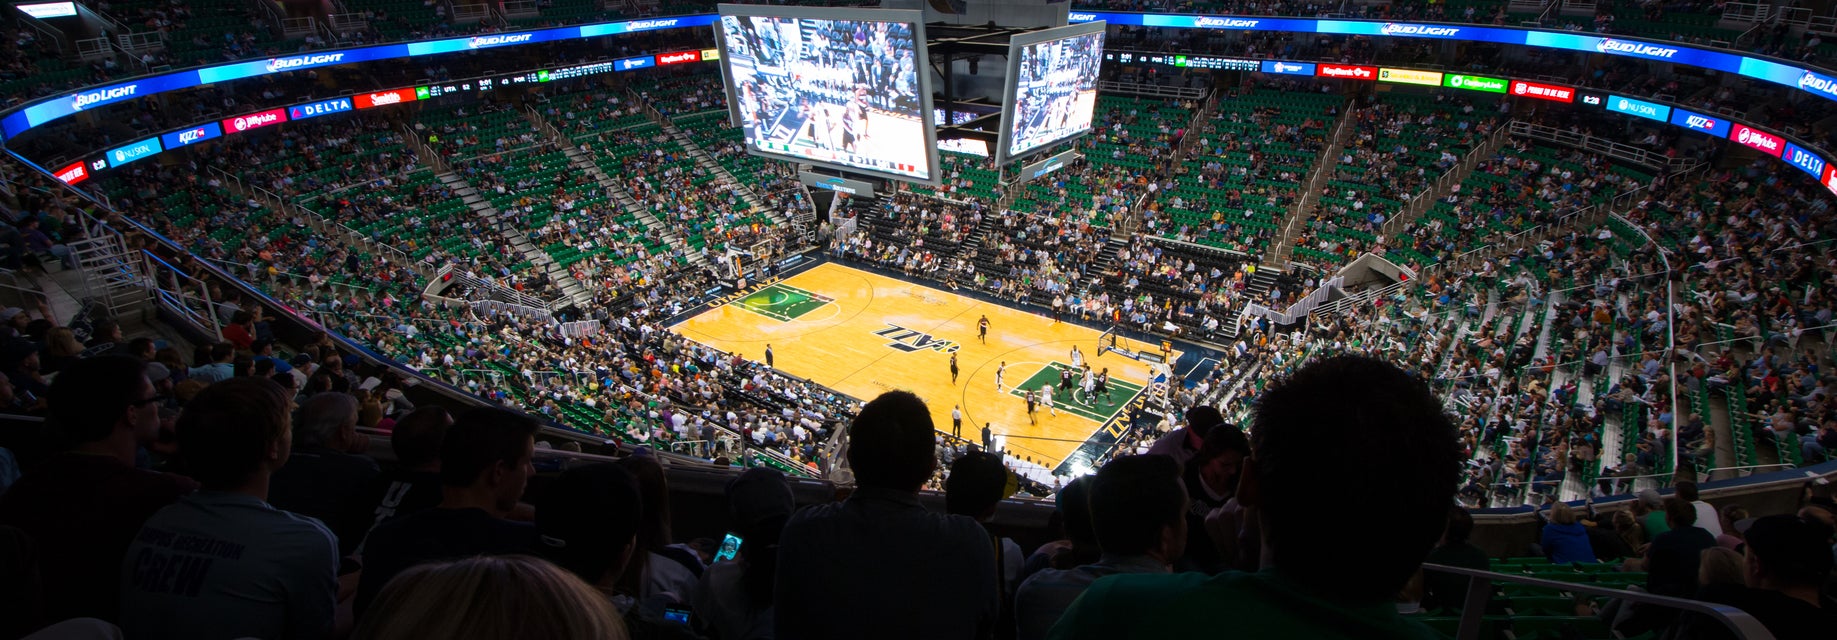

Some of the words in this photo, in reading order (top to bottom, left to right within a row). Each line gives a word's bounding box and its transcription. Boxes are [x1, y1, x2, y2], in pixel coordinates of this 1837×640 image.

[631, 20, 652, 30] BUD
[650, 19, 678, 28] LIGHT
[1068, 13, 1096, 21] LIGHT
[1201, 17, 1225, 27] BUD
[1224, 18, 1259, 28] LIGHT
[1388, 24, 1418, 34] BUD
[1416, 25, 1460, 36] LIGHT
[475, 37, 500, 47] BUD
[499, 33, 533, 44] LIGHT
[1604, 39, 1636, 53] BUD
[1634, 43, 1678, 58] LIGHT
[273, 58, 304, 70] BUD
[303, 53, 345, 66] LIGHT
[1802, 73, 1826, 91] BUD
[76, 92, 102, 108] BUD
[101, 84, 138, 101] LIGHT
[305, 100, 350, 116] DELTA
[1793, 150, 1824, 176] DELTA
[706, 289, 750, 308] UTAH
[132, 547, 213, 597] CREW
